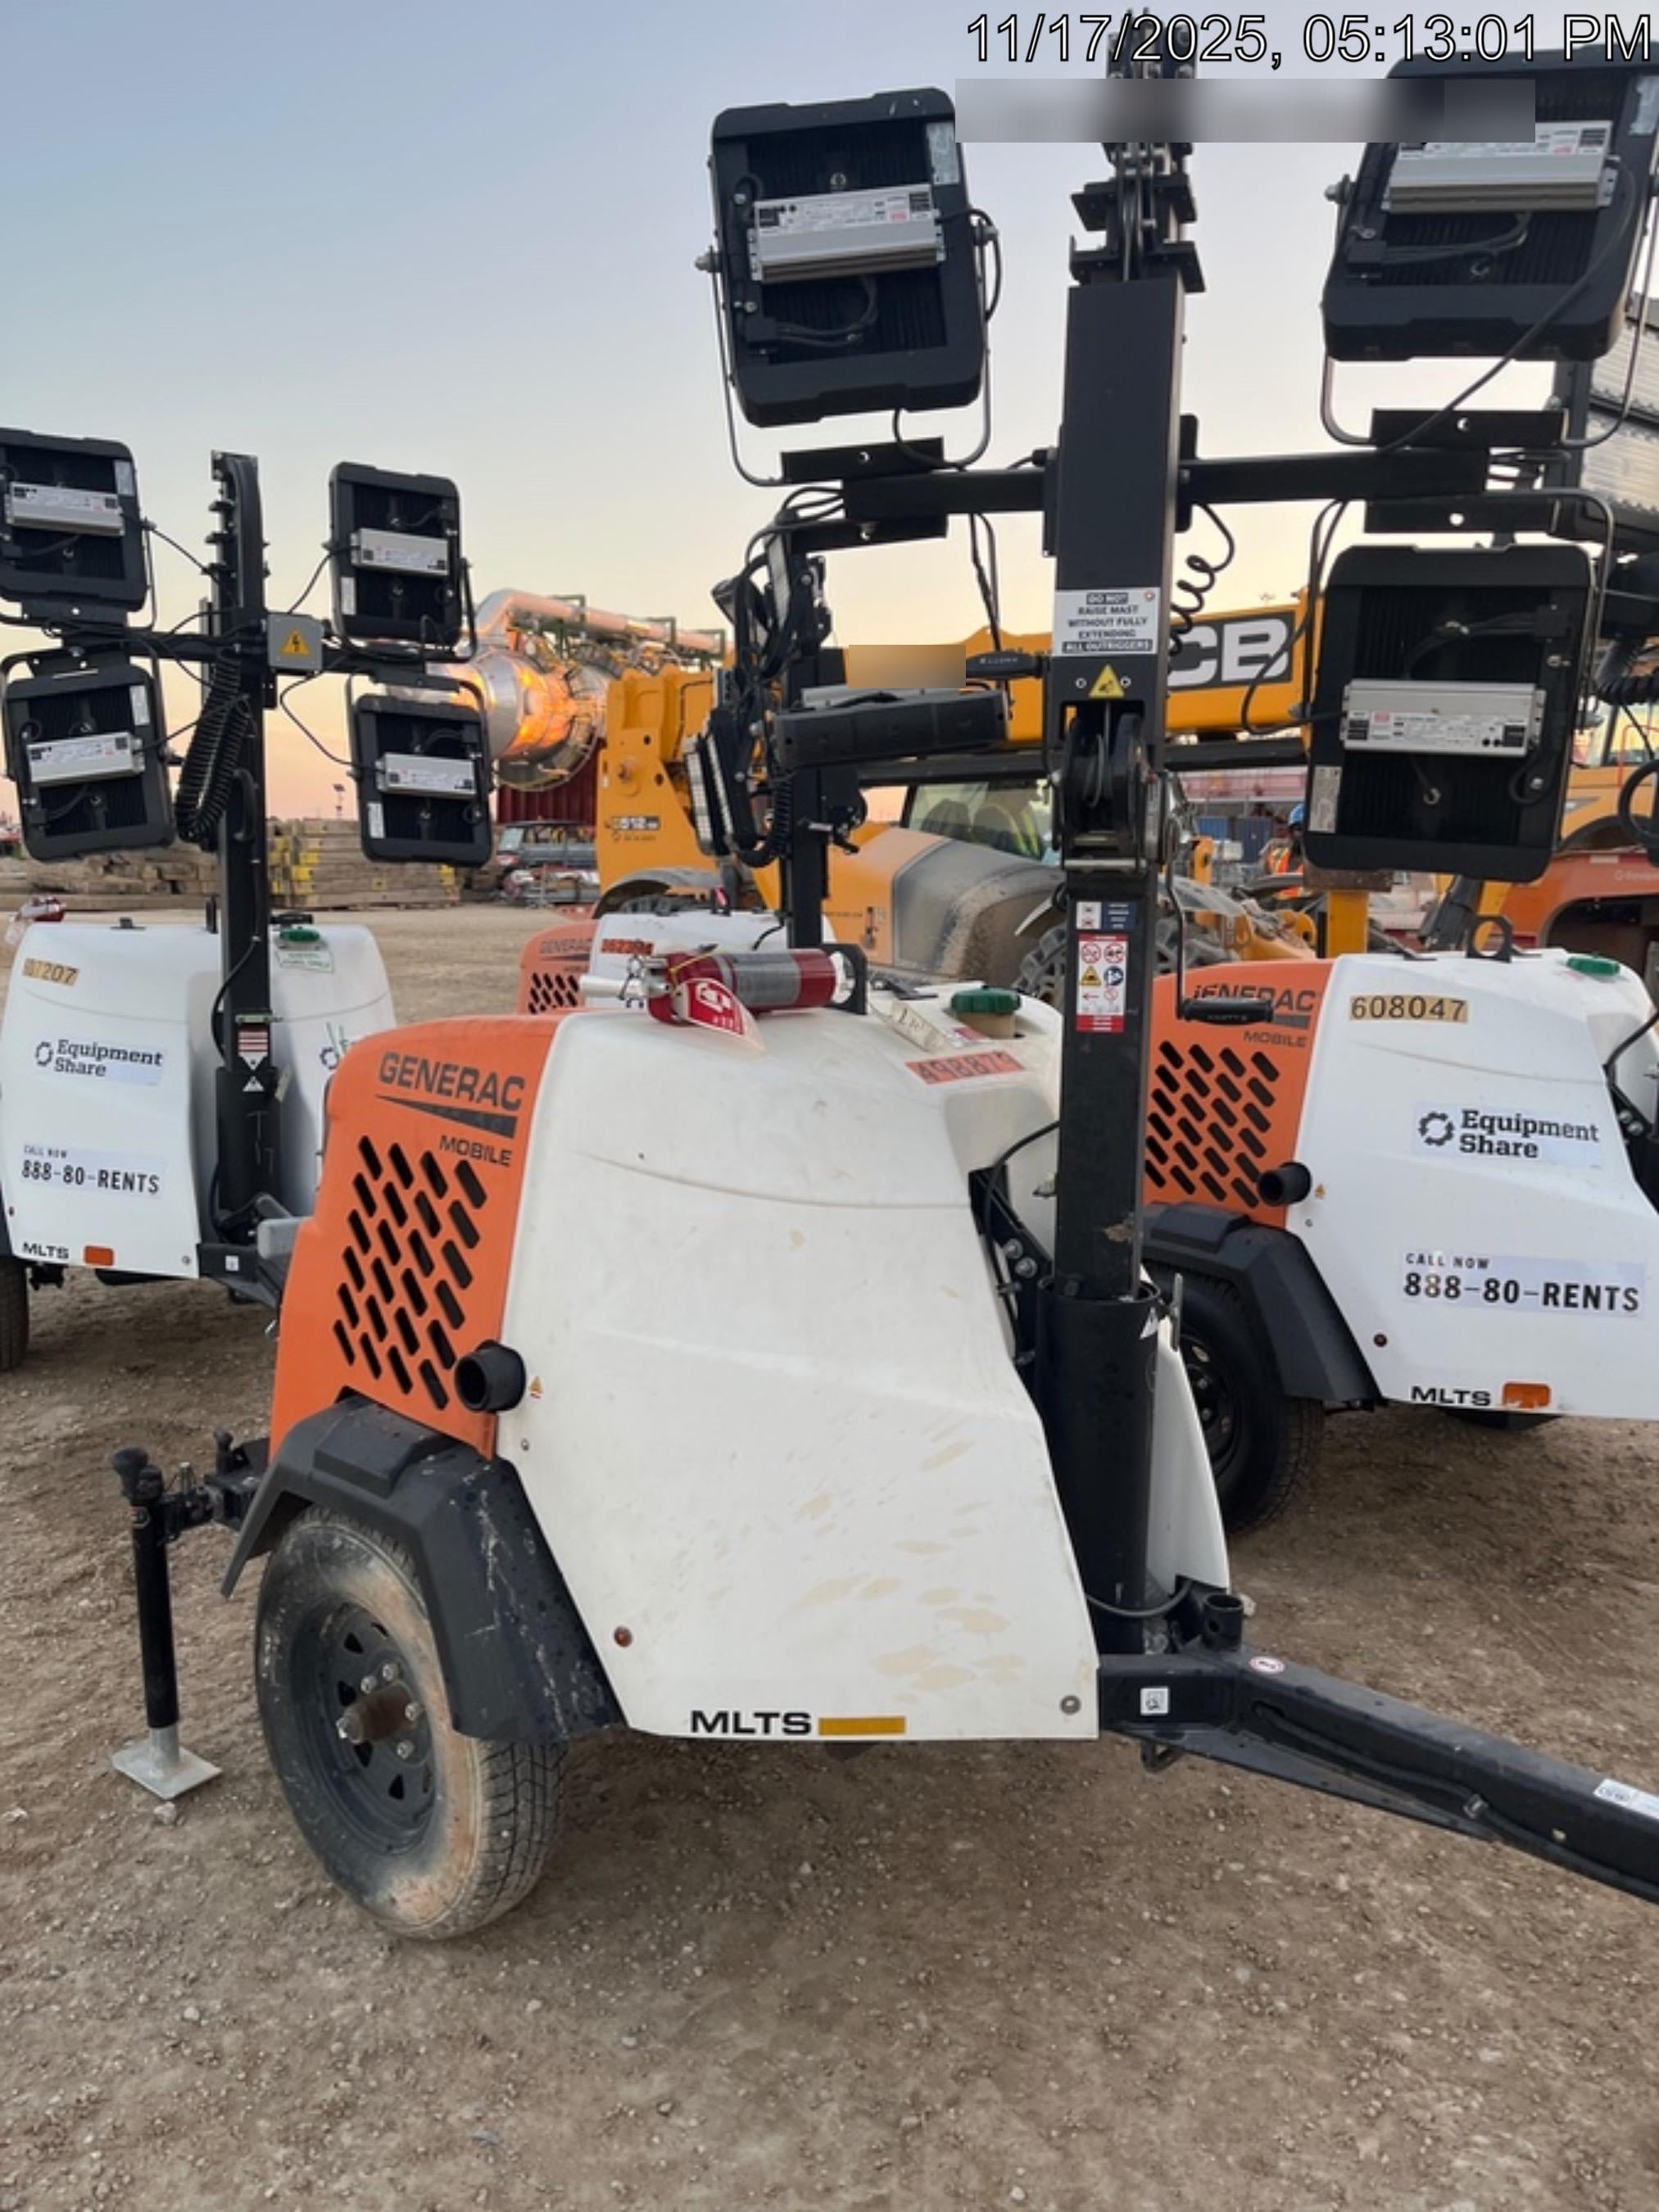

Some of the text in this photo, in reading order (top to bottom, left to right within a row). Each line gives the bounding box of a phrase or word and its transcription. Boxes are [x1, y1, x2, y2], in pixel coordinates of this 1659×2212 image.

[1067, 616, 1149, 628] WITHOUT FULLY
[1078, 605, 1139, 614] RAISE MAST
[1078, 629, 1136, 639] EXTENDING
[1167, 619, 1289, 687] CB
[1351, 995, 1466, 1022] 608047
[1243, 1022, 1307, 1047] MOBILE
[57, 1039, 163, 1067] Equipment
[54, 1057, 107, 1077] Share
[378, 1050, 526, 1112] GENERAC
[1461, 1108, 1600, 1143] Equipment
[439, 1134, 513, 1167] MOBILE
[1459, 1133, 1539, 1158] Share
[22, 1159, 160, 1195] 888-80-RENTS
[23, 1240, 70, 1260] MLTS
[1405, 1253, 1490, 1270] CALL NOW
[1403, 1271, 1639, 1312] 888-80-RENTS
[1411, 1385, 1492, 1407] MLTS
[691, 1710, 812, 1735] MLTS
